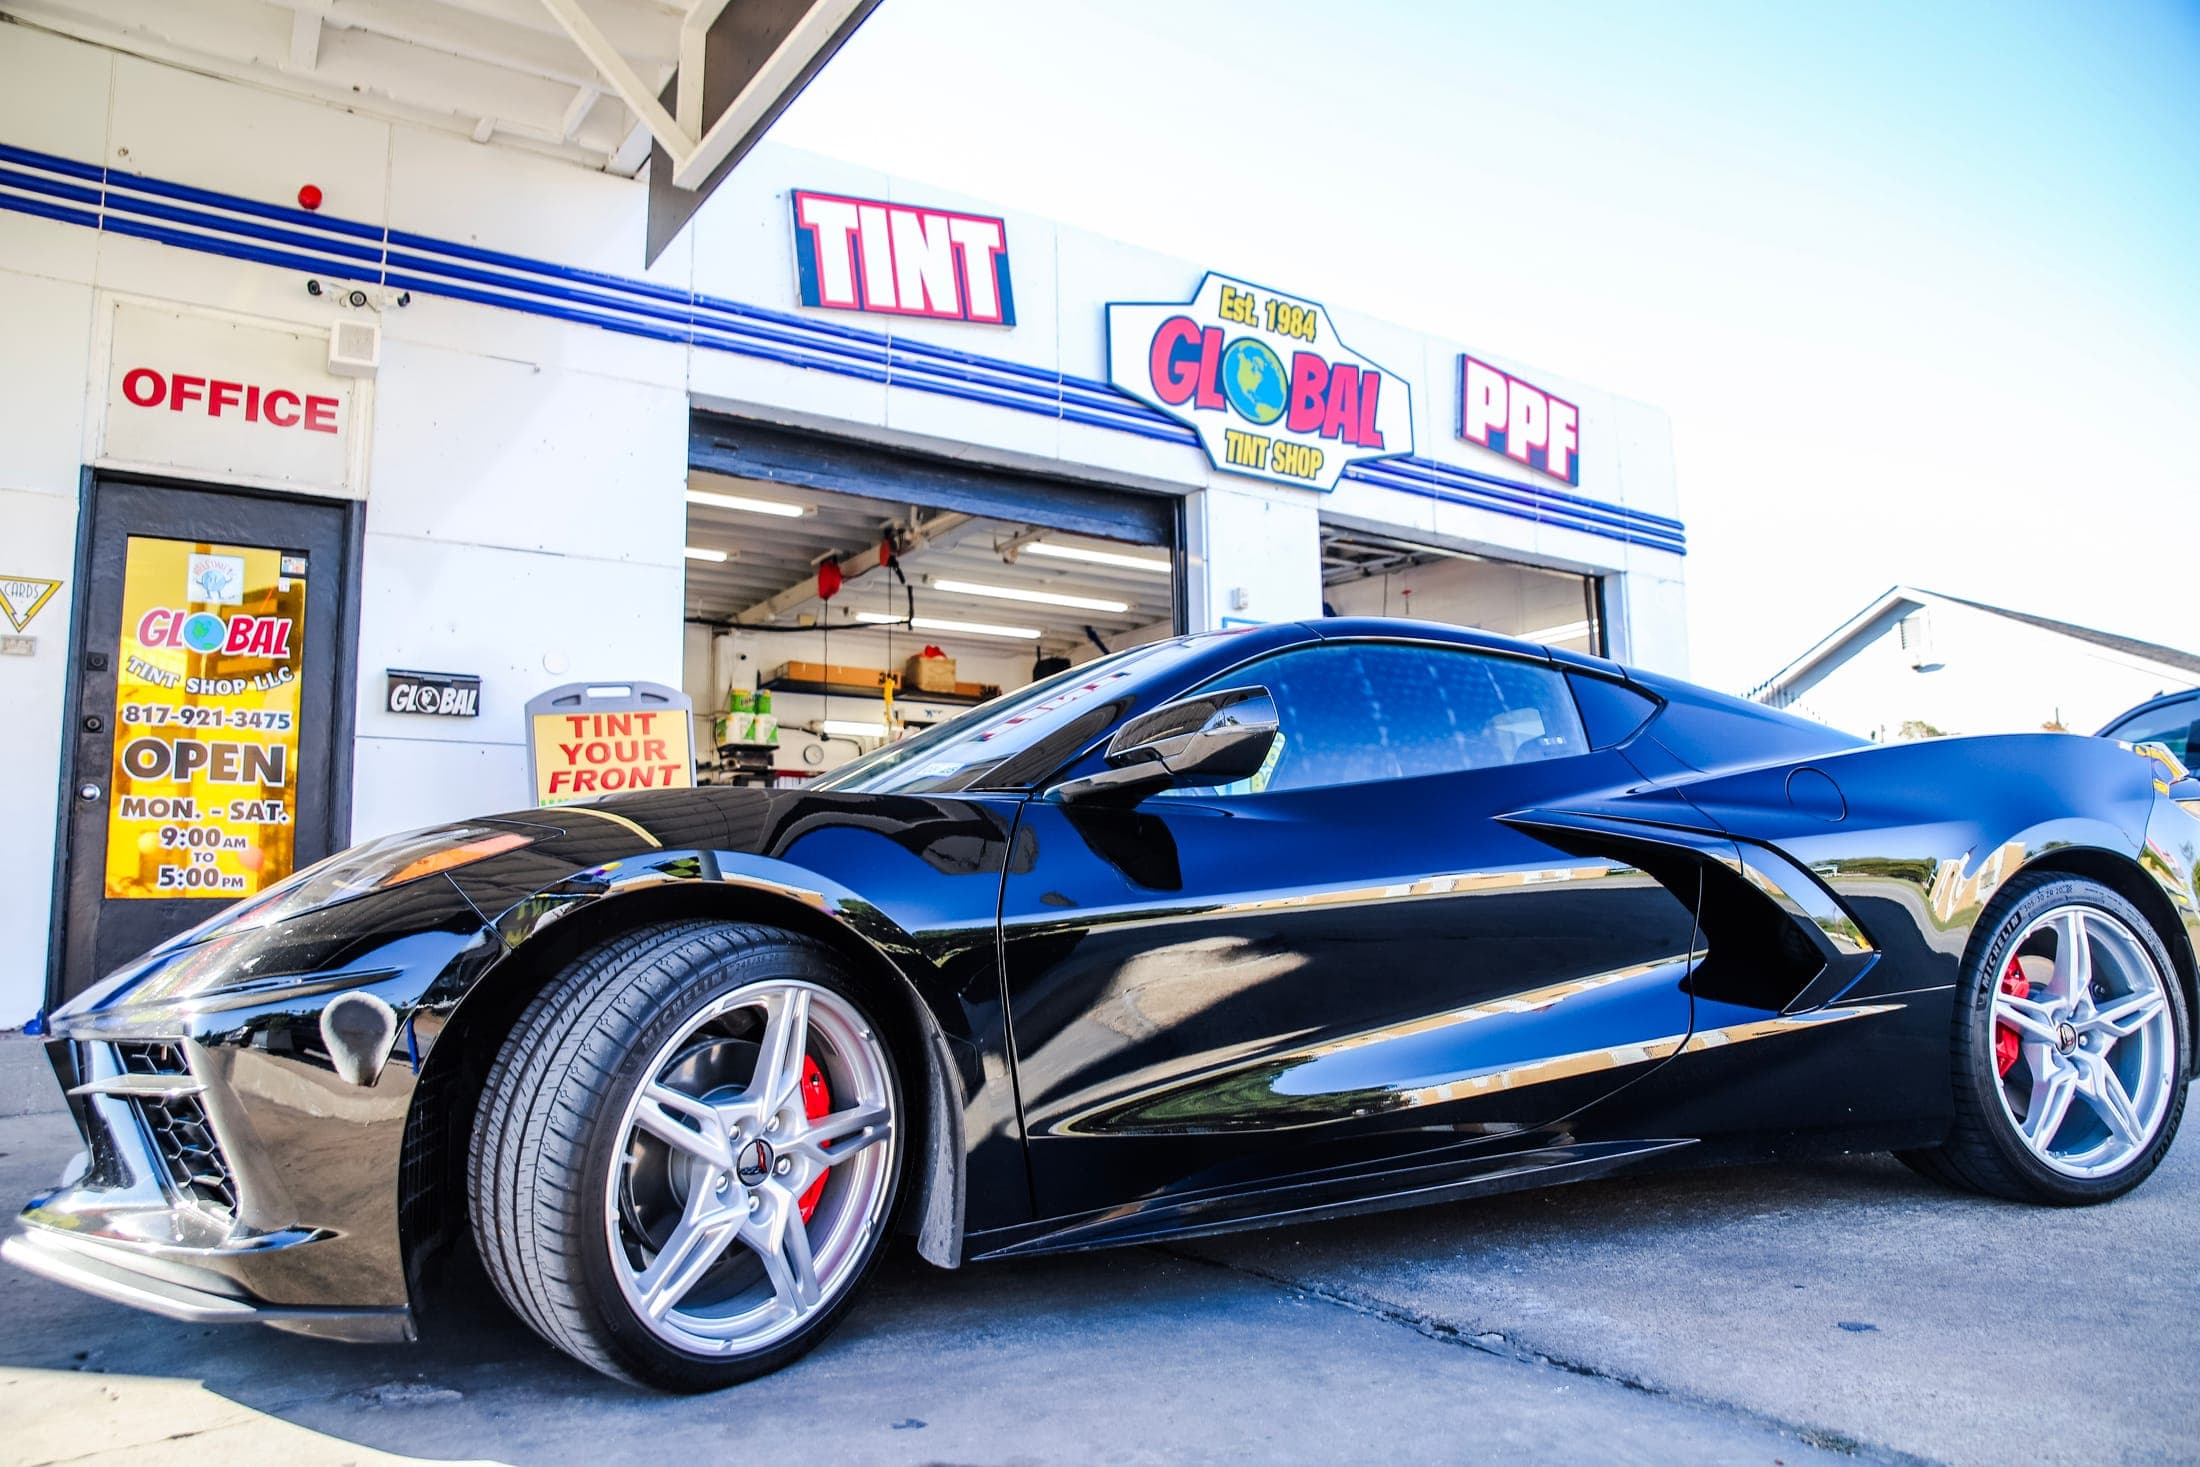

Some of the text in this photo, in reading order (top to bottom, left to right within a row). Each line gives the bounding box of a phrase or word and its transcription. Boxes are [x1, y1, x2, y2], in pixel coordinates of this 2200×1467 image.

[798, 194, 1003, 320] TINT
[1219, 285, 1316, 342] Est. 1984
[122, 368, 339, 434] OFFICE
[1149, 315, 1385, 450] GLOBAL
[1464, 355, 1578, 482] PPF
[1225, 431, 1324, 480] TINT SHOP
[5, 582, 38, 599] CARDS
[138, 607, 291, 657] GLOBAL
[127, 656, 294, 695] TINT SHOP LLC
[125, 705, 291, 730] 817-921-3475
[390, 684, 477, 716] GLOBAL
[566, 712, 657, 738] TINT
[124, 738, 285, 784] OPEN
[559, 739, 667, 766] YOUR
[549, 764, 681, 793] FRONT
[121, 798, 201, 819] MON.
[230, 801, 288, 821] SAT.
[161, 827, 246, 848] 9:00 AM
[193, 852, 214, 863] TO
[159, 867, 244, 888] 5:00 PM
[1982, 913, 2020, 989] MICHELIN
[641, 967, 727, 1048] MICHELIN
